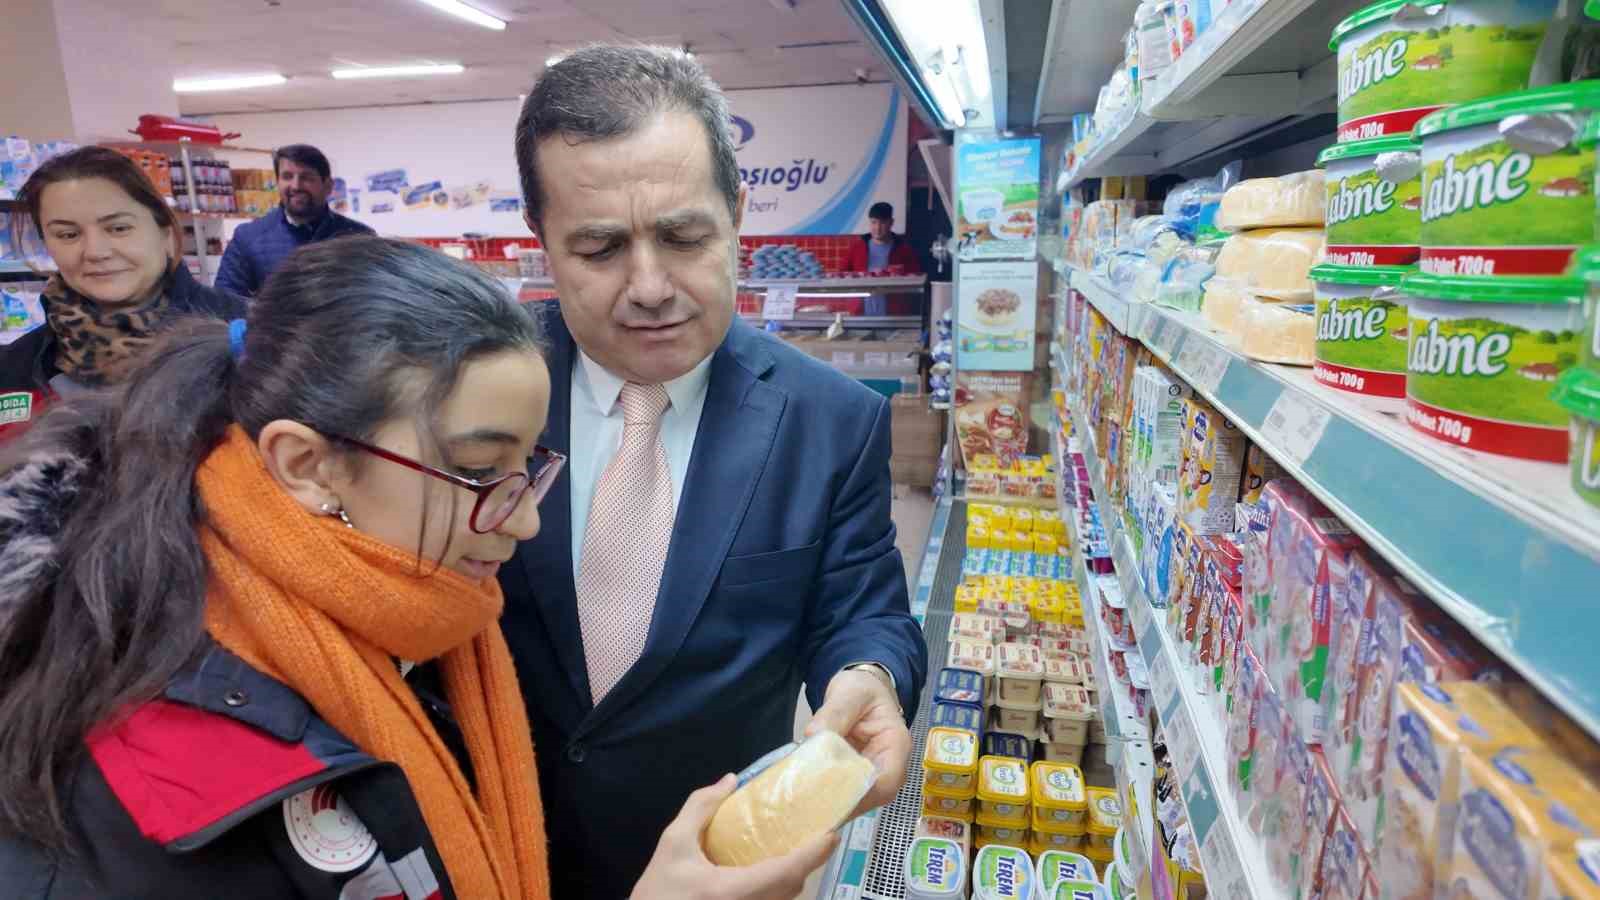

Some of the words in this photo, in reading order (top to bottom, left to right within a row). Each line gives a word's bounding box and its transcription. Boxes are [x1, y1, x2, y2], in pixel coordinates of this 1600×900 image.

[1315, 297, 1387, 341] abne
[927, 847, 946, 885] TEREM
[998, 855, 1016, 896] TEREM
